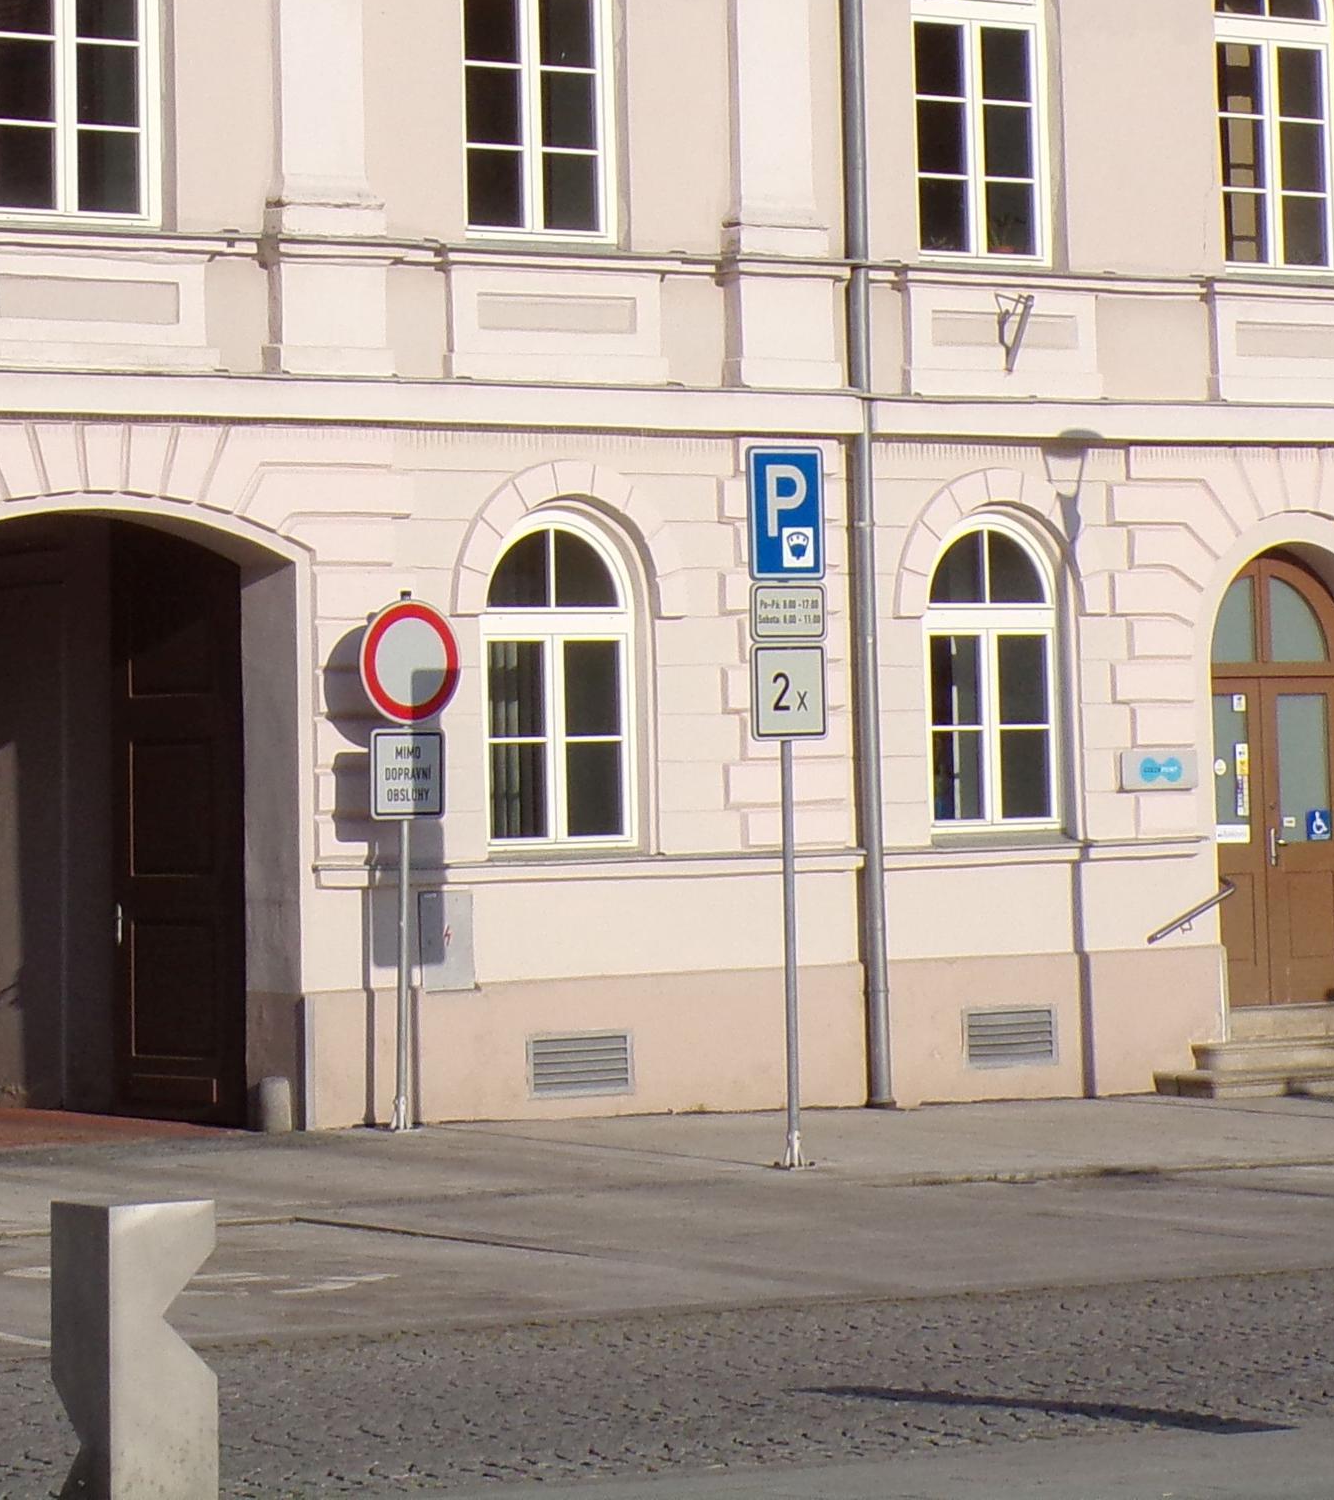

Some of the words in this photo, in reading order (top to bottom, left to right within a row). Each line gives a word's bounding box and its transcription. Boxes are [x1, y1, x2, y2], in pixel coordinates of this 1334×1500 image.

[766, 464, 807, 537] P
[395, 746, 421, 760] MIMO
[385, 764, 431, 781] DOPRAVNÍ
[387, 788, 430, 802] OBSLUHY
